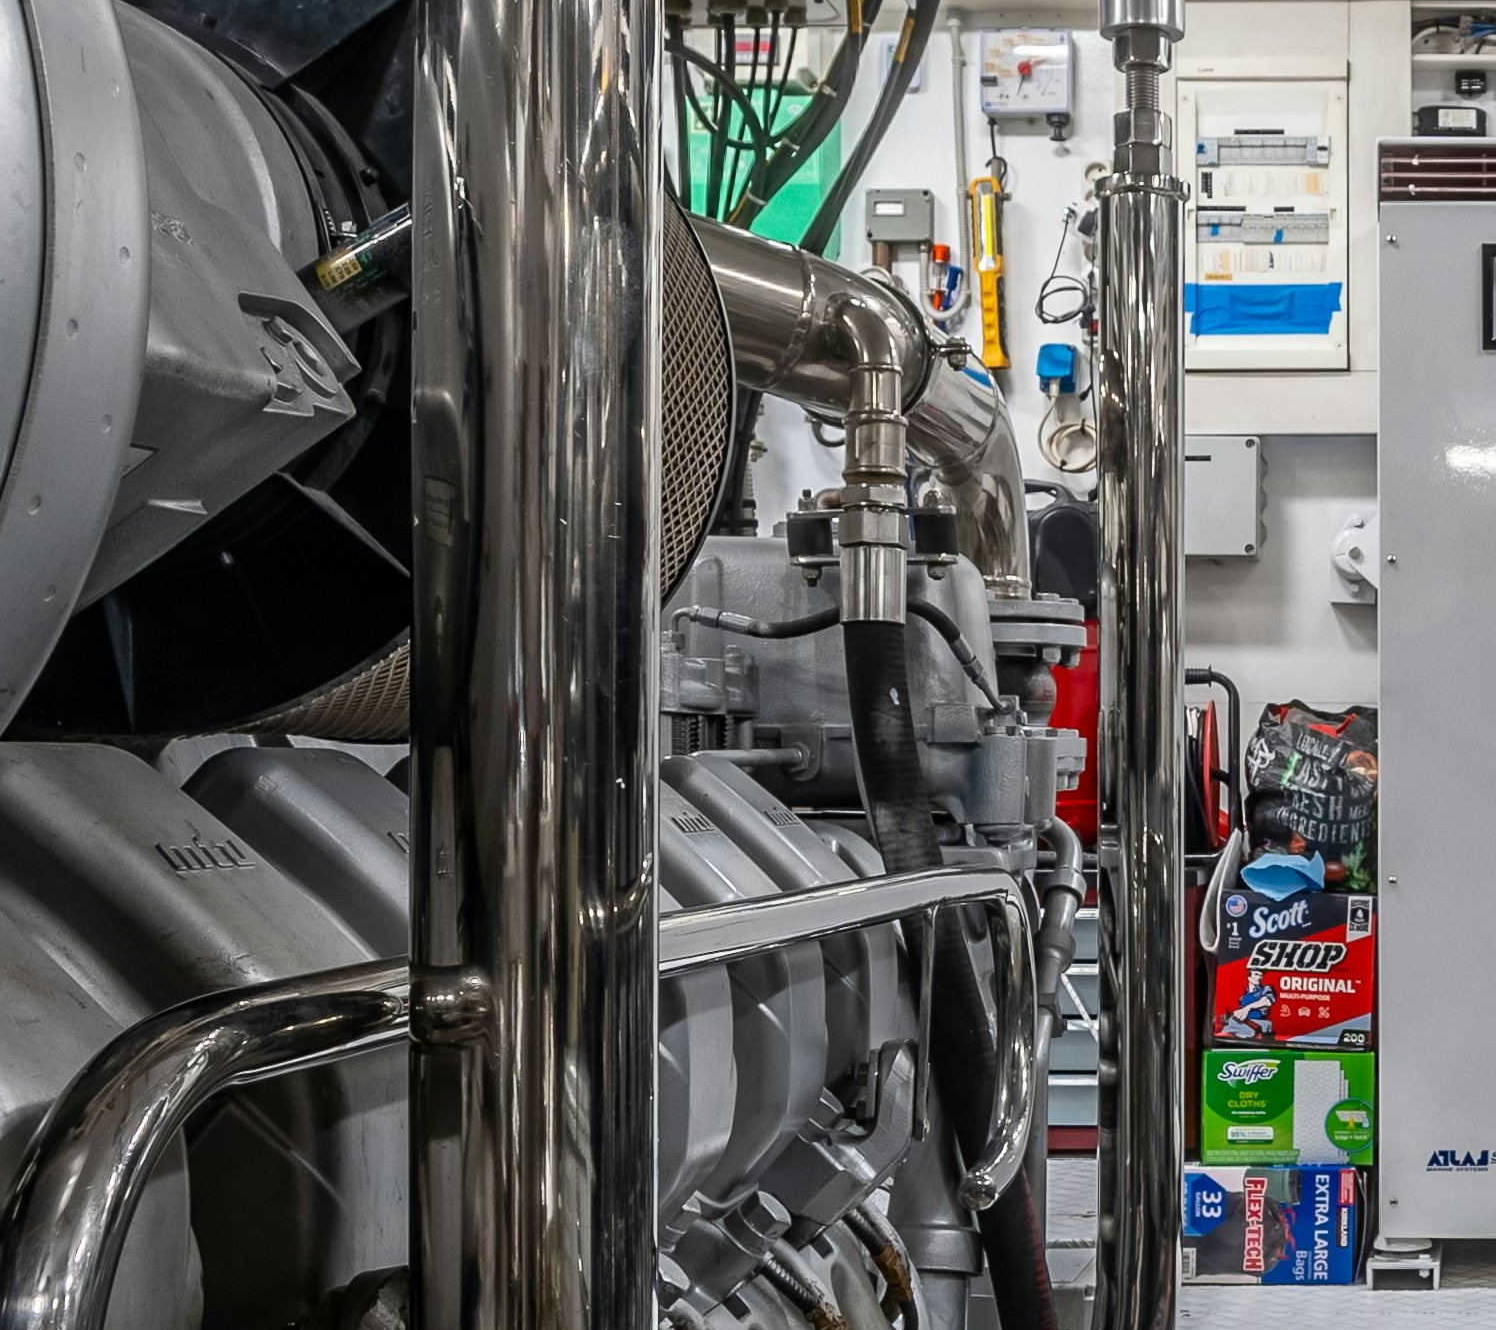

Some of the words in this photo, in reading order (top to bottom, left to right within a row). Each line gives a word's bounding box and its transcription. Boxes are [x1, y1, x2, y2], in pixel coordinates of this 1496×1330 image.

[1248, 900, 1309, 938] Scott
[1247, 939, 1347, 972] SHOP
[1343, 1033, 1365, 1043] 200
[1217, 1061, 1277, 1084] Swiffer
[1227, 1100, 1266, 1108] CLOTHS
[1239, 1091, 1259, 1099] DRY
[1202, 1190, 1222, 1218] 33
[1315, 1174, 1330, 1226] EXTRA
[1243, 1177, 1268, 1272] FLEX-TECH
[1292, 1250, 1308, 1281] Bags
[1313, 1230, 1329, 1281] LARGE
